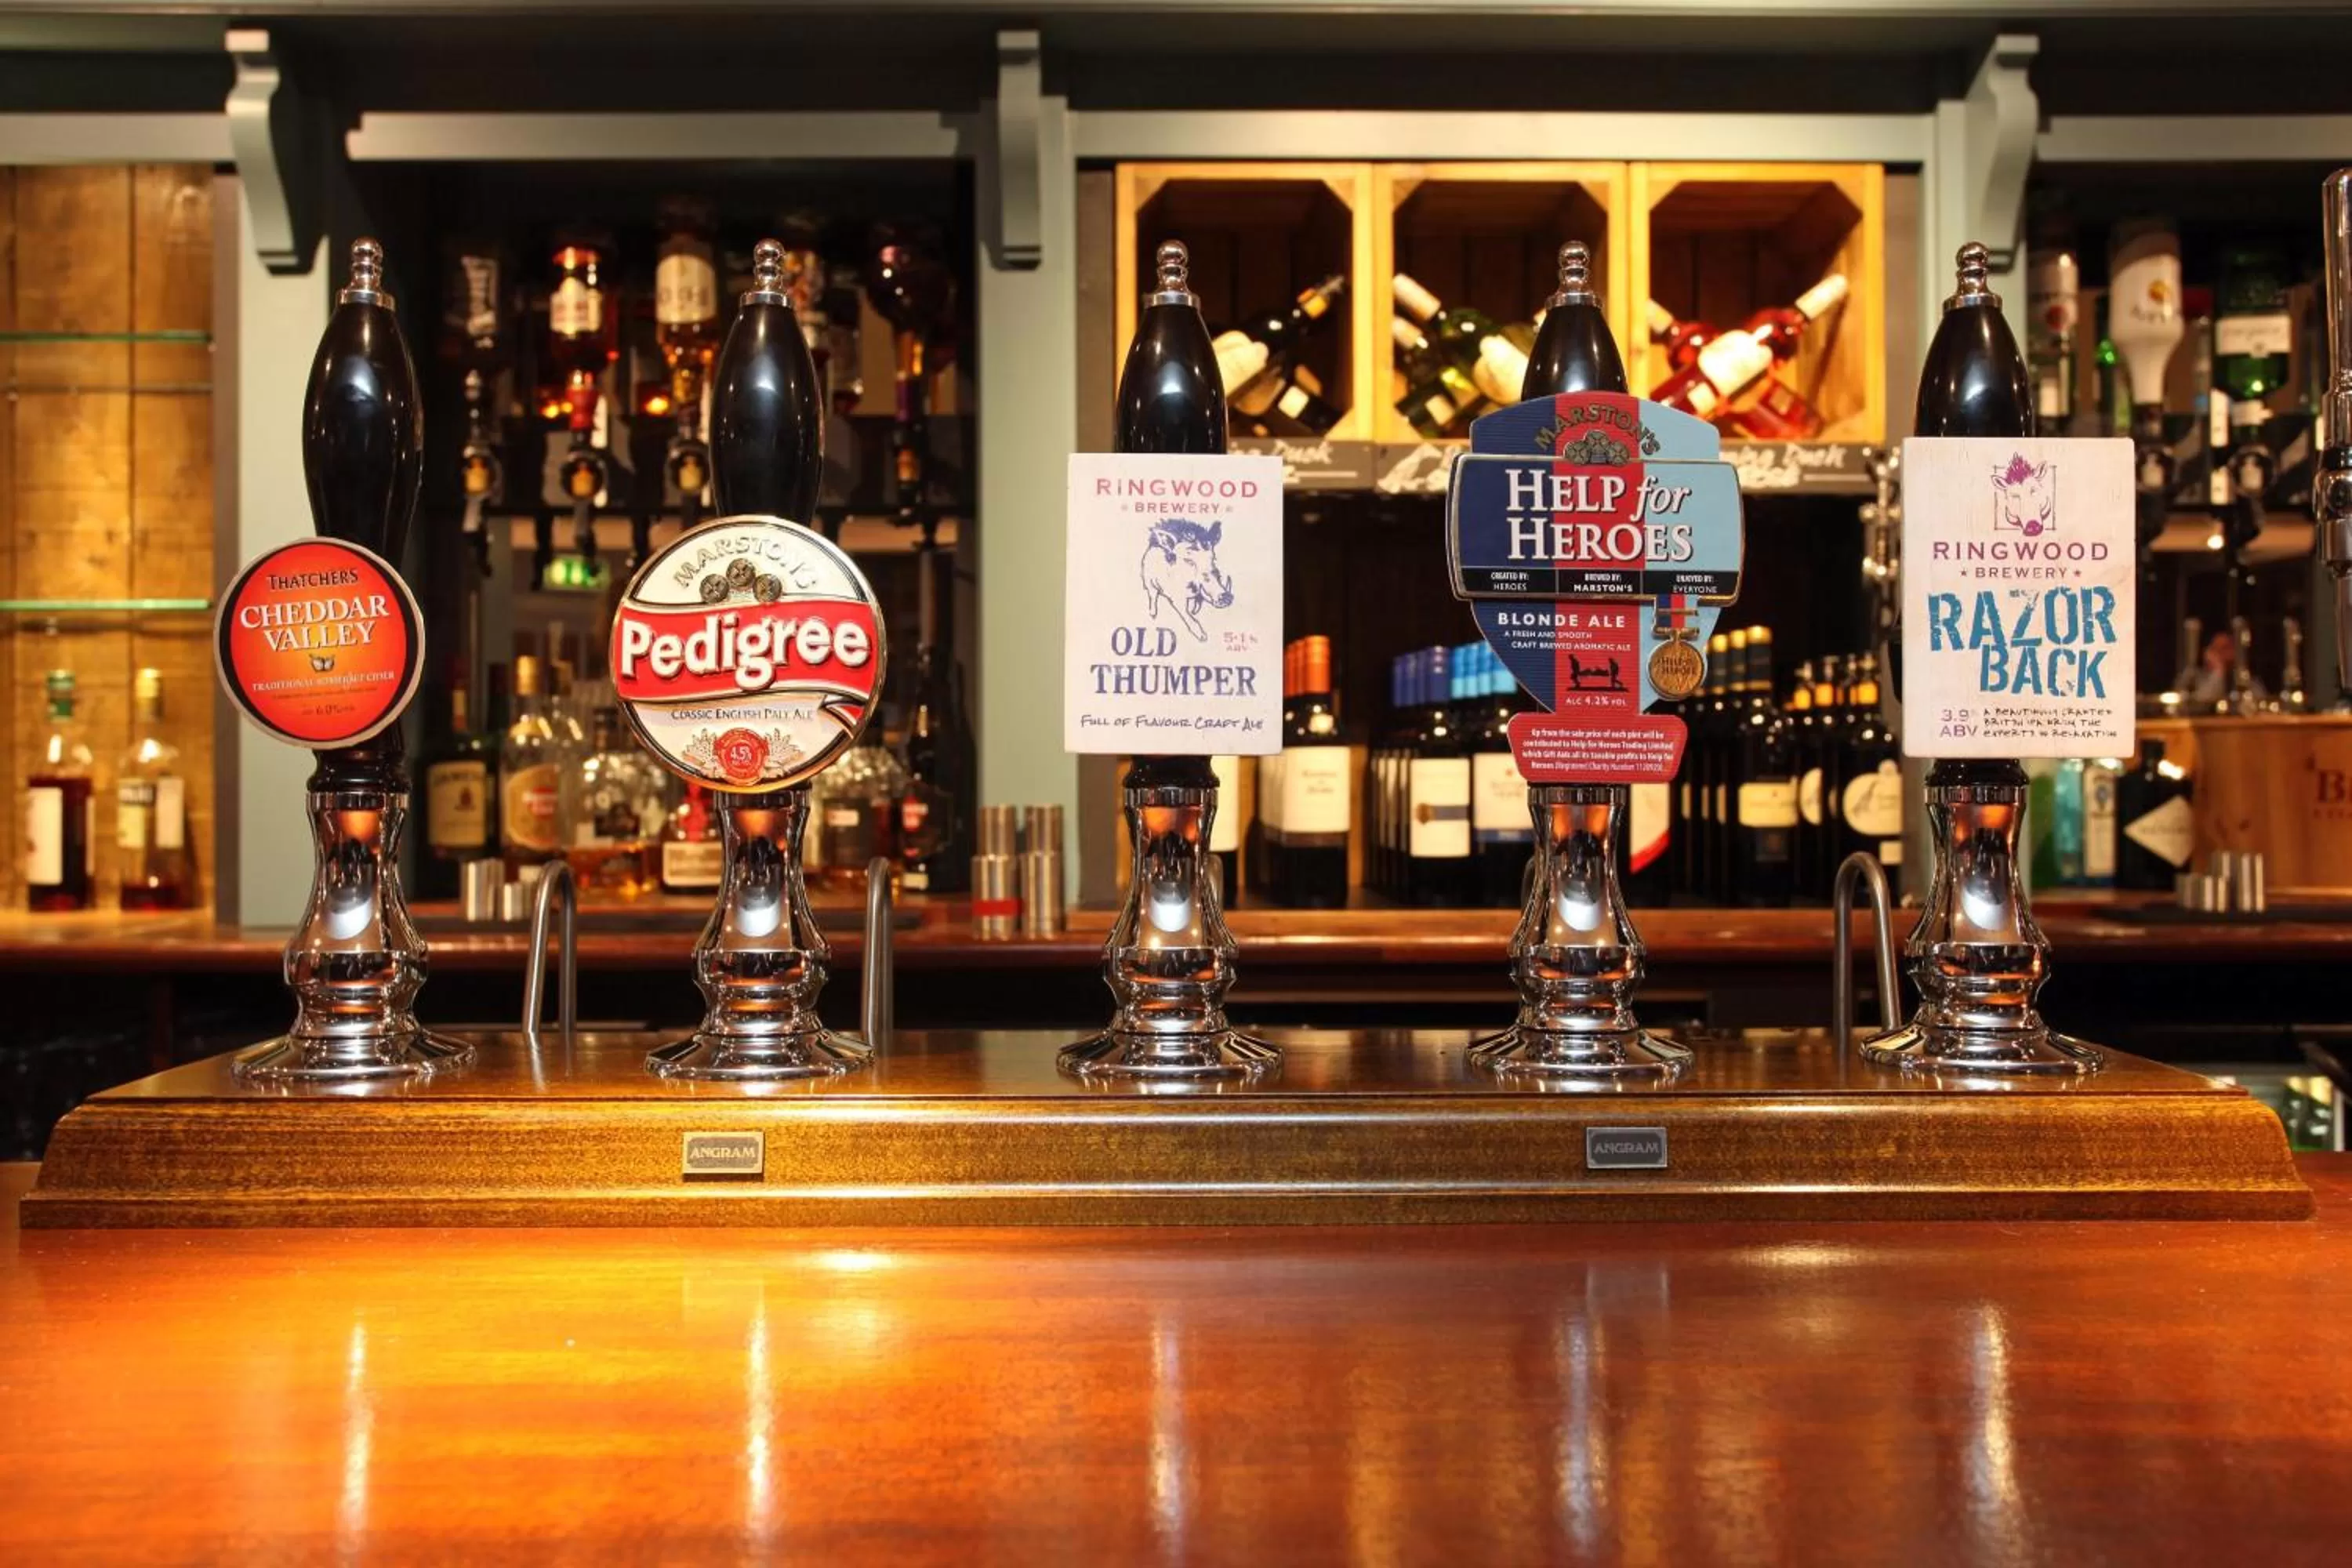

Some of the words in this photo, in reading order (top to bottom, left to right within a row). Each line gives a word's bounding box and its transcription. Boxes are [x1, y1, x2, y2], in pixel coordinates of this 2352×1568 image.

[1534, 403, 1661, 455] MARSTON'S
[1096, 477, 1258, 499] RINGWOOD
[1505, 469, 1625, 514] HELP
[1630, 476, 1692, 521] for
[1134, 503, 1221, 514] BREWERY
[1506, 517, 1693, 561] HEROES
[1933, 542, 2109, 561] RINGWOOD
[269, 569, 358, 590] THATCHERS
[1490, 572, 1518, 581] CREATED
[1975, 567, 2068, 579] BREWERY
[1493, 583, 1527, 591] HEROES
[1573, 583, 1633, 593] MARSTON'S
[1672, 586, 1718, 594] EVERYONE
[240, 594, 390, 629] CHEDDAR
[1498, 612, 1578, 627] BLONDE
[1588, 615, 1625, 628] ALE
[1928, 586, 2117, 652] RAZOR
[263, 620, 376, 653] VALLEY
[1111, 626, 1177, 657] OLD
[620, 612, 872, 691] Pedigree
[1539, 641, 1573, 650] BREWED
[1616, 643, 1632, 652] ALE
[1980, 642, 2107, 699] BACK
[1090, 664, 1258, 696] THUMPER
[1584, 695, 1608, 705] 4.2%
[1940, 709, 1969, 722] 3.9
[1940, 724, 1978, 737] ABV
[689, 1147, 756, 1159] ANGRAM
[1593, 1142, 1660, 1154] ANGRAM
